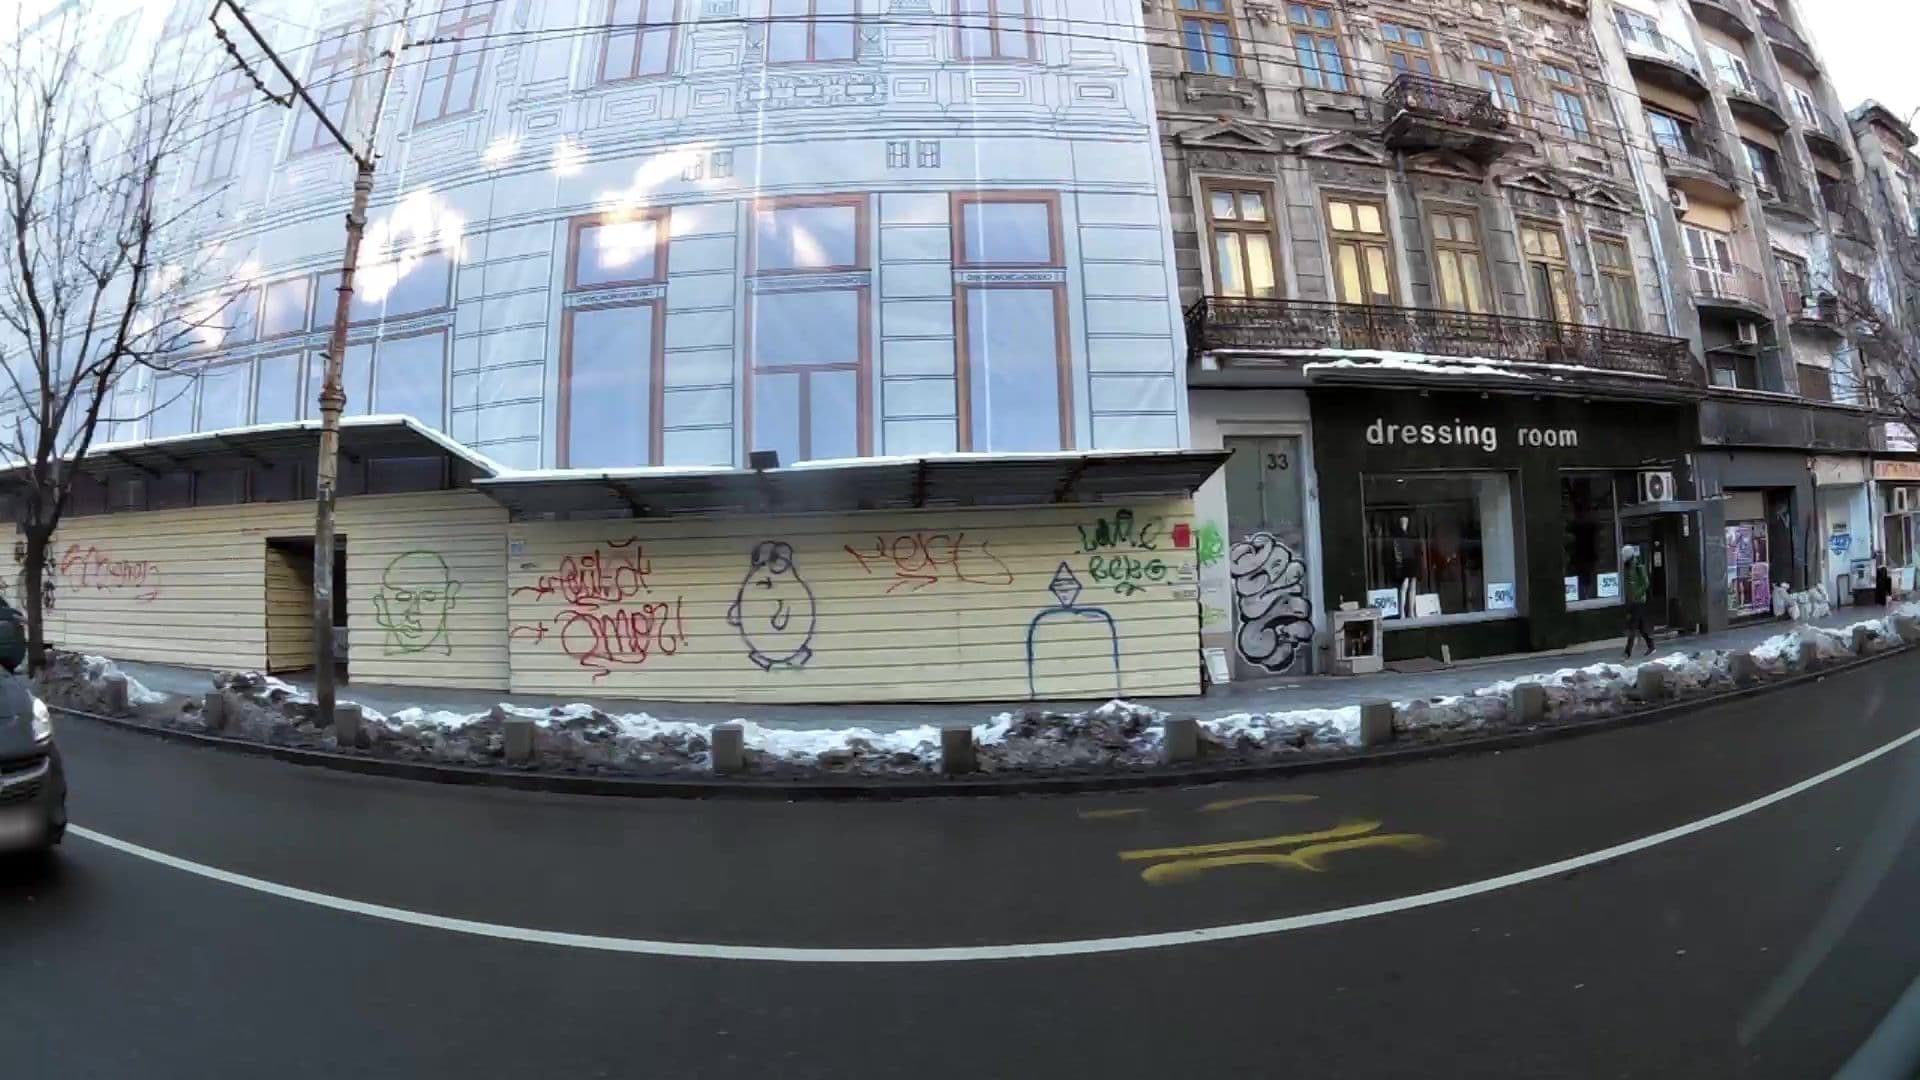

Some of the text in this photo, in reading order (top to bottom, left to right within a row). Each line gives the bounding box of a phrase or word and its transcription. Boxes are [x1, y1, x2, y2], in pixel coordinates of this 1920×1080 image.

[1366, 418, 1578, 452] dressing room
[1267, 453, 1288, 470] 33
